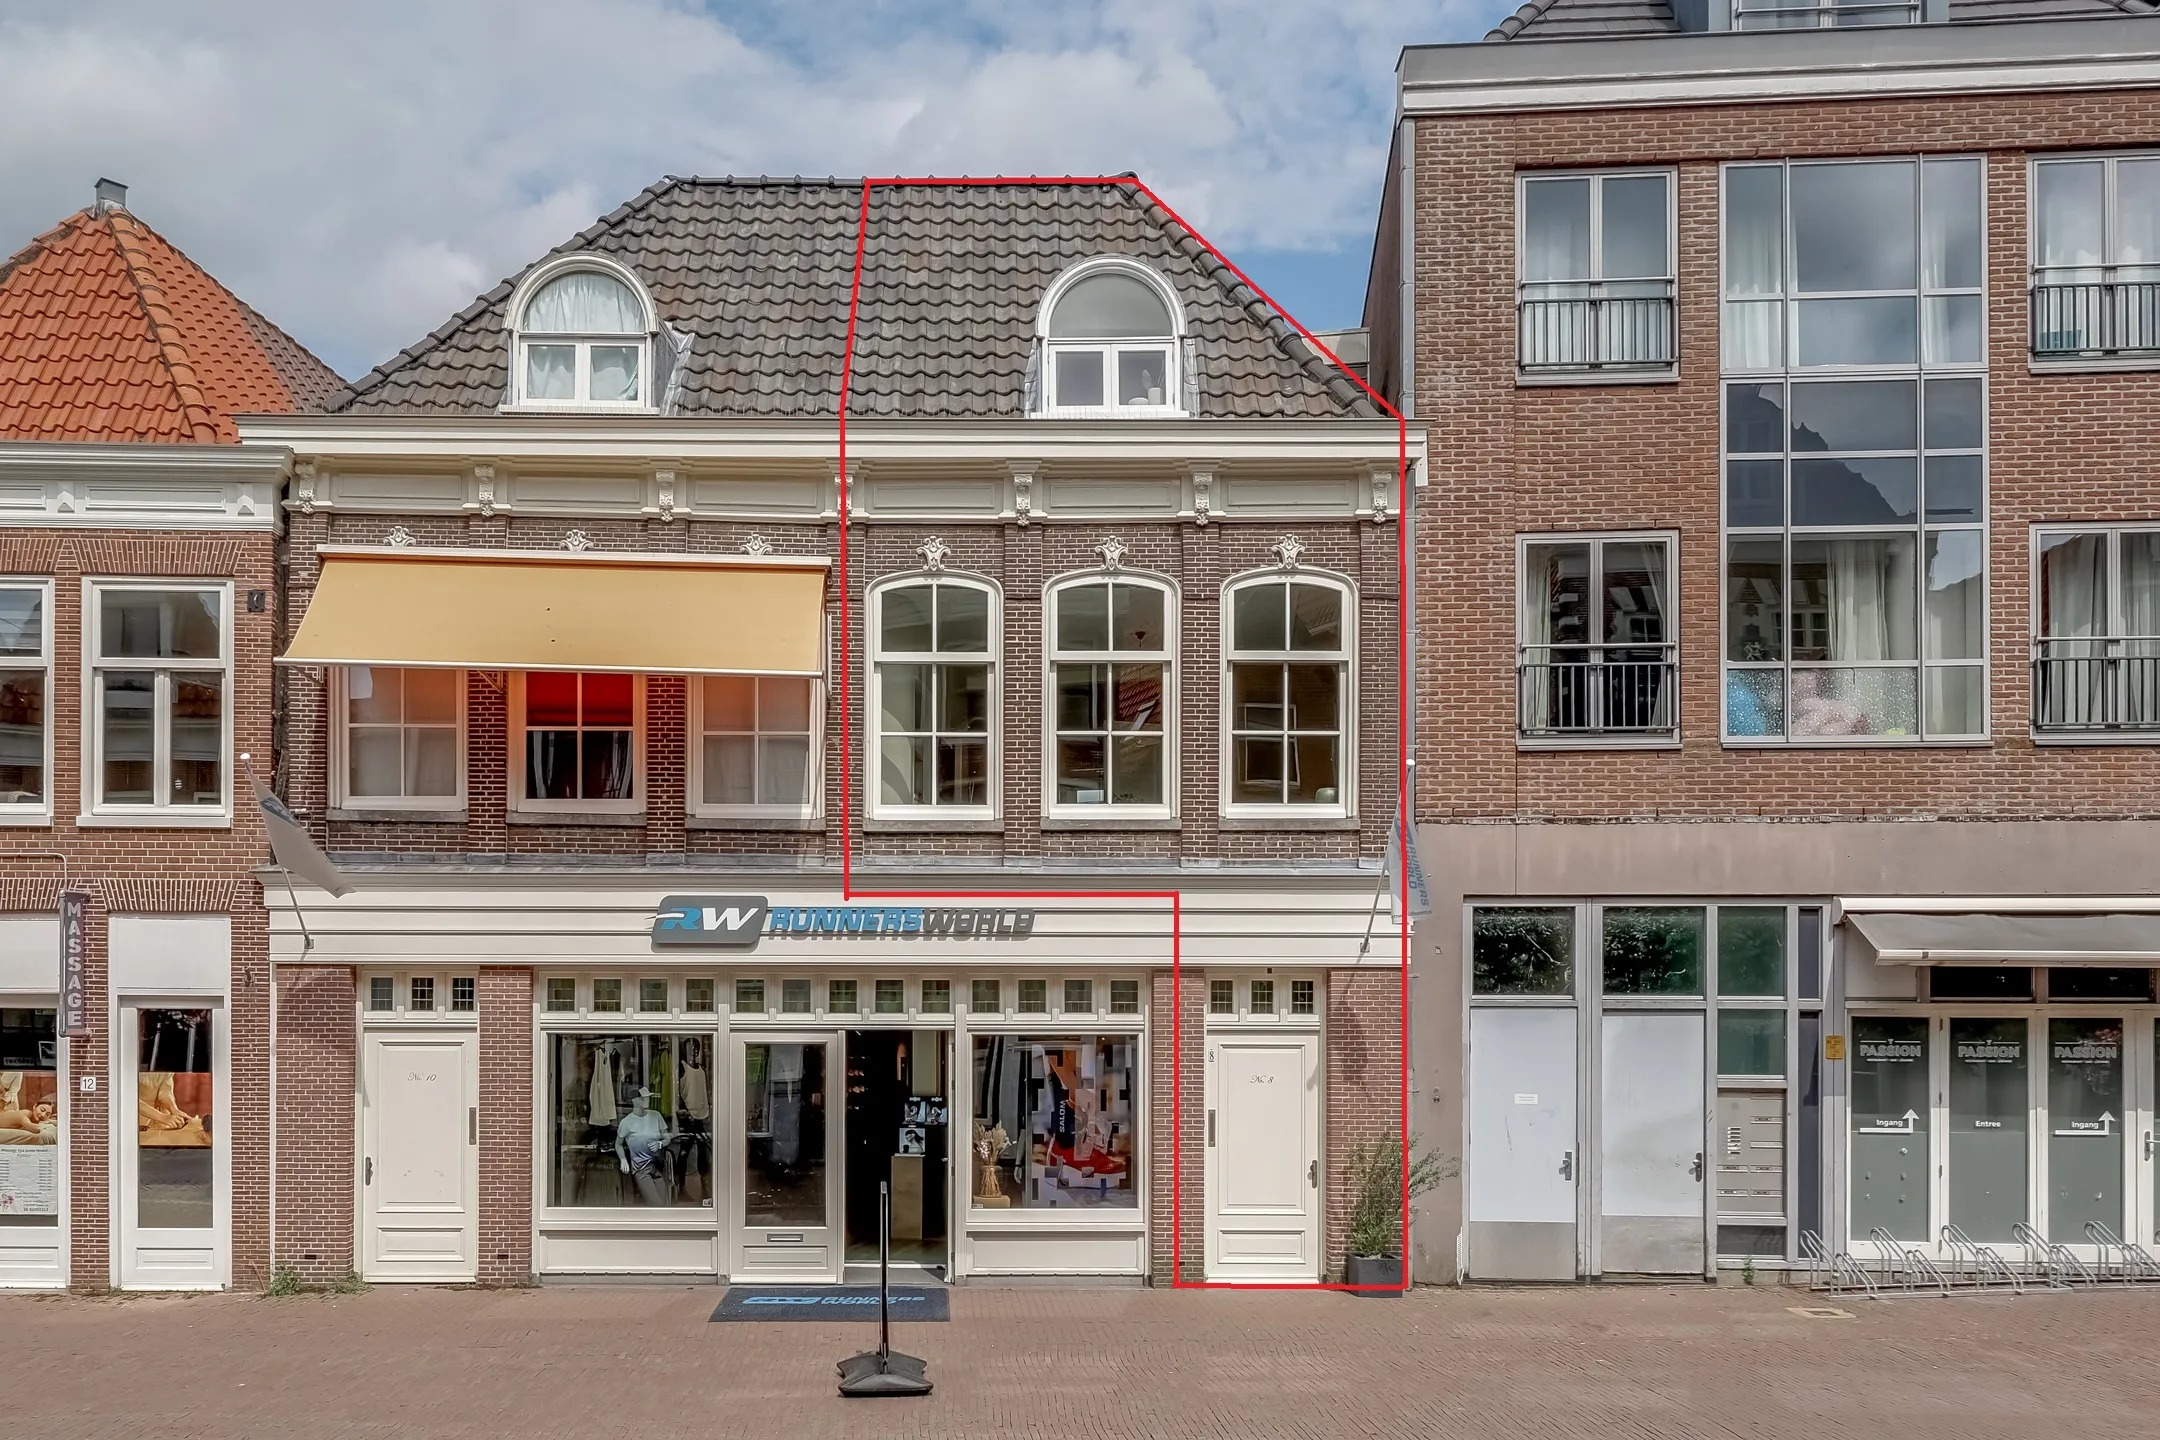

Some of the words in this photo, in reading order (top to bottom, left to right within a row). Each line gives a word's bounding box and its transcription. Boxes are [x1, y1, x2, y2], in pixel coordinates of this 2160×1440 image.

[1408, 846, 1429, 906] RUNNERS
[660, 907, 759, 931] RW
[67, 902, 82, 1026] MASSAGE
[1860, 1044, 1921, 1057] PASSION
[1958, 1045, 2020, 1058] PASSION
[2054, 1046, 2117, 1058] PASSION
[83, 1078, 94, 1089] 12
[426, 1074, 437, 1082] 10
[1267, 1076, 1275, 1084] 8
[1876, 1119, 1903, 1128] Ingang
[2071, 1121, 2099, 1129] Ingang
